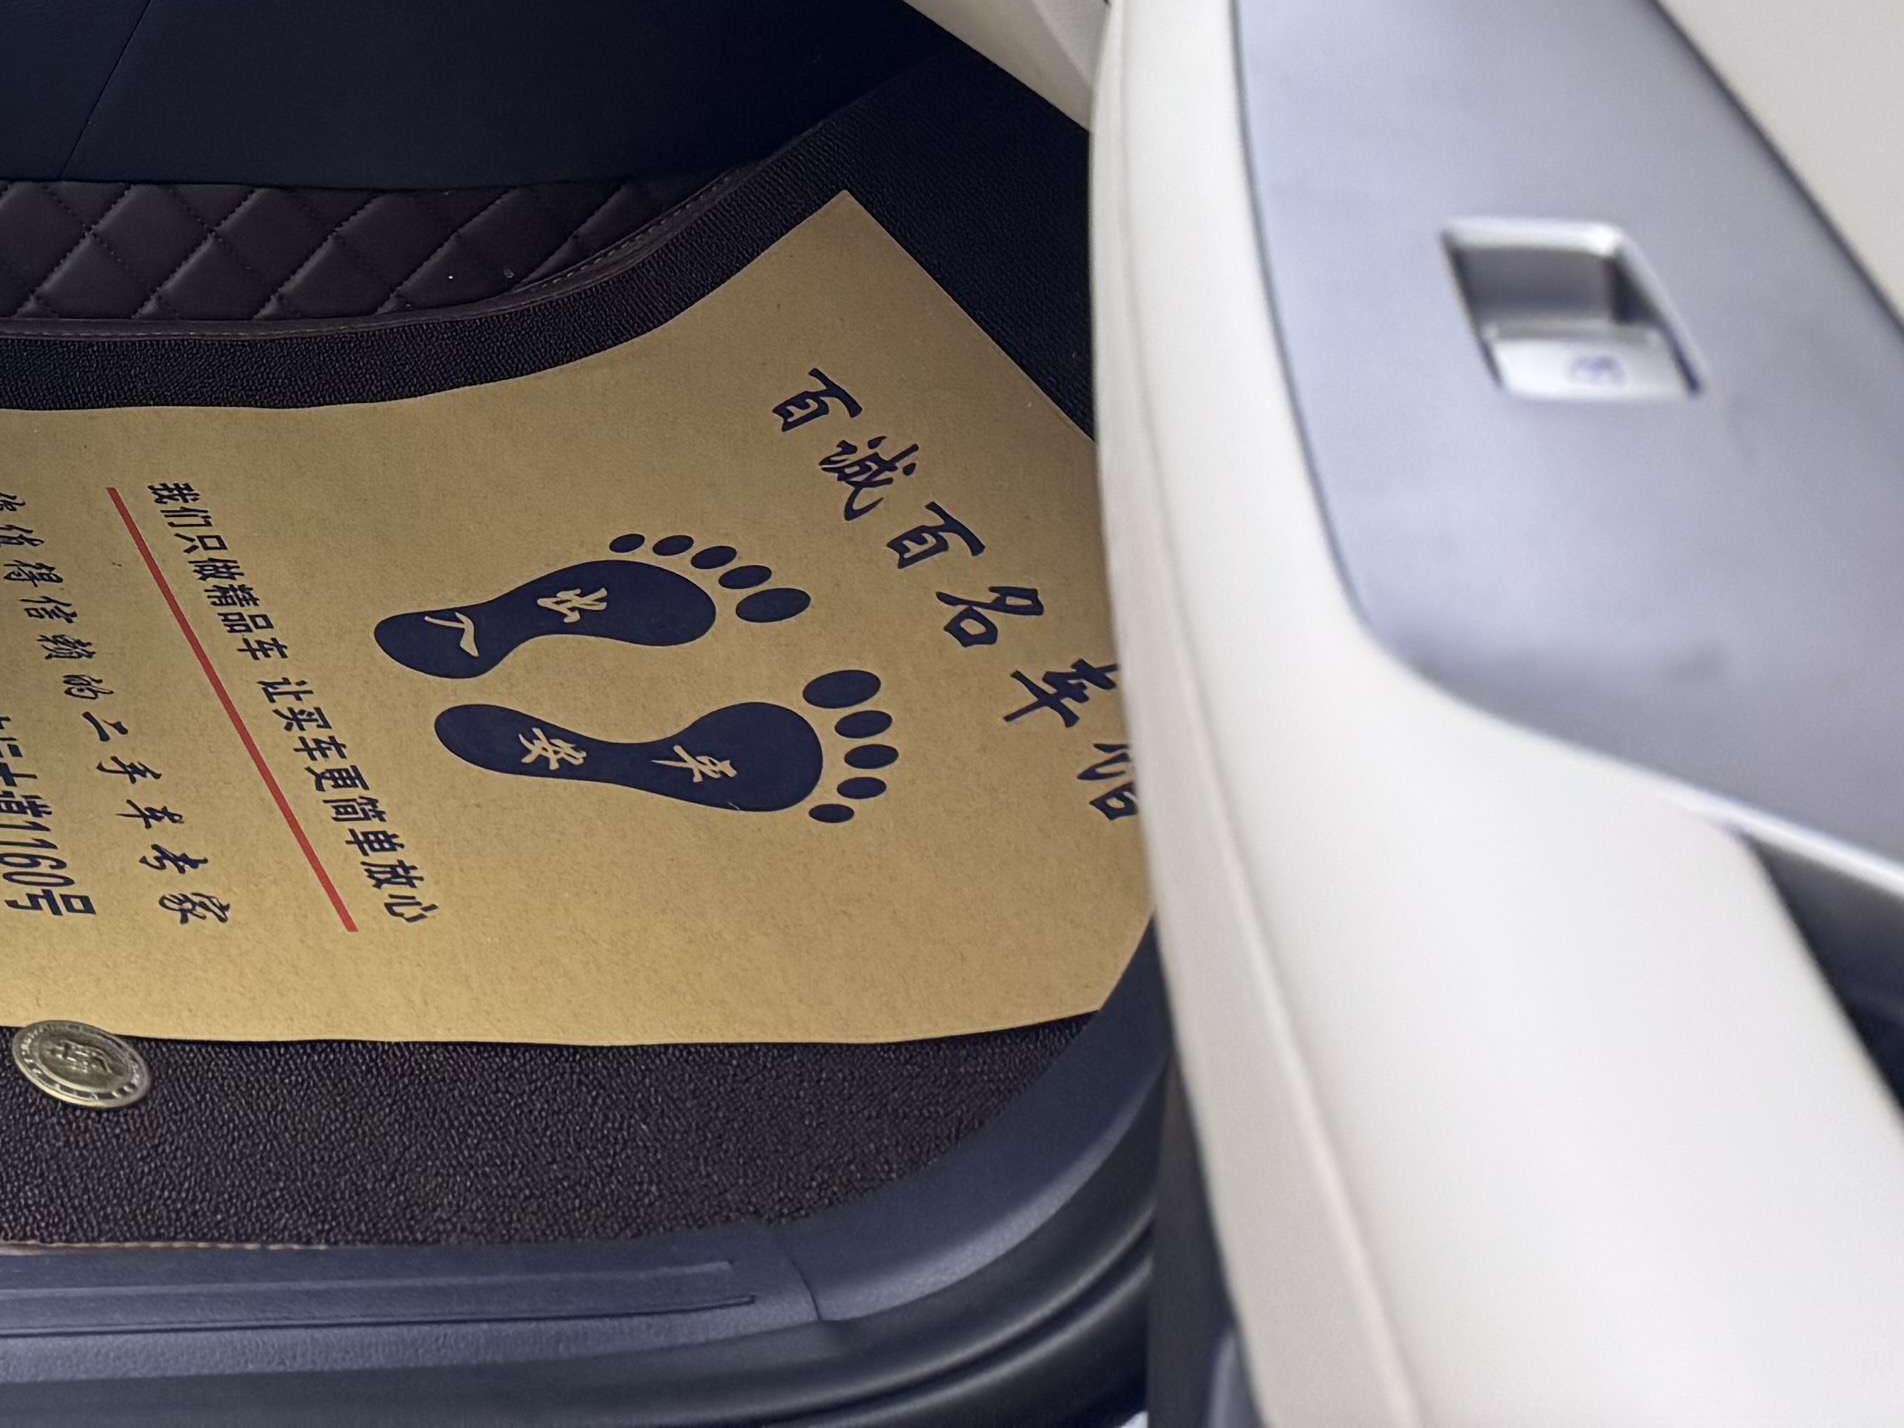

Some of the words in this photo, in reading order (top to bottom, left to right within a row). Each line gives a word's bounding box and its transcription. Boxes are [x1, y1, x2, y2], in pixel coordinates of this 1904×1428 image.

[148, 481, 291, 662] 我们只做精品车
[257, 676, 440, 923] 让买车更简单放心
